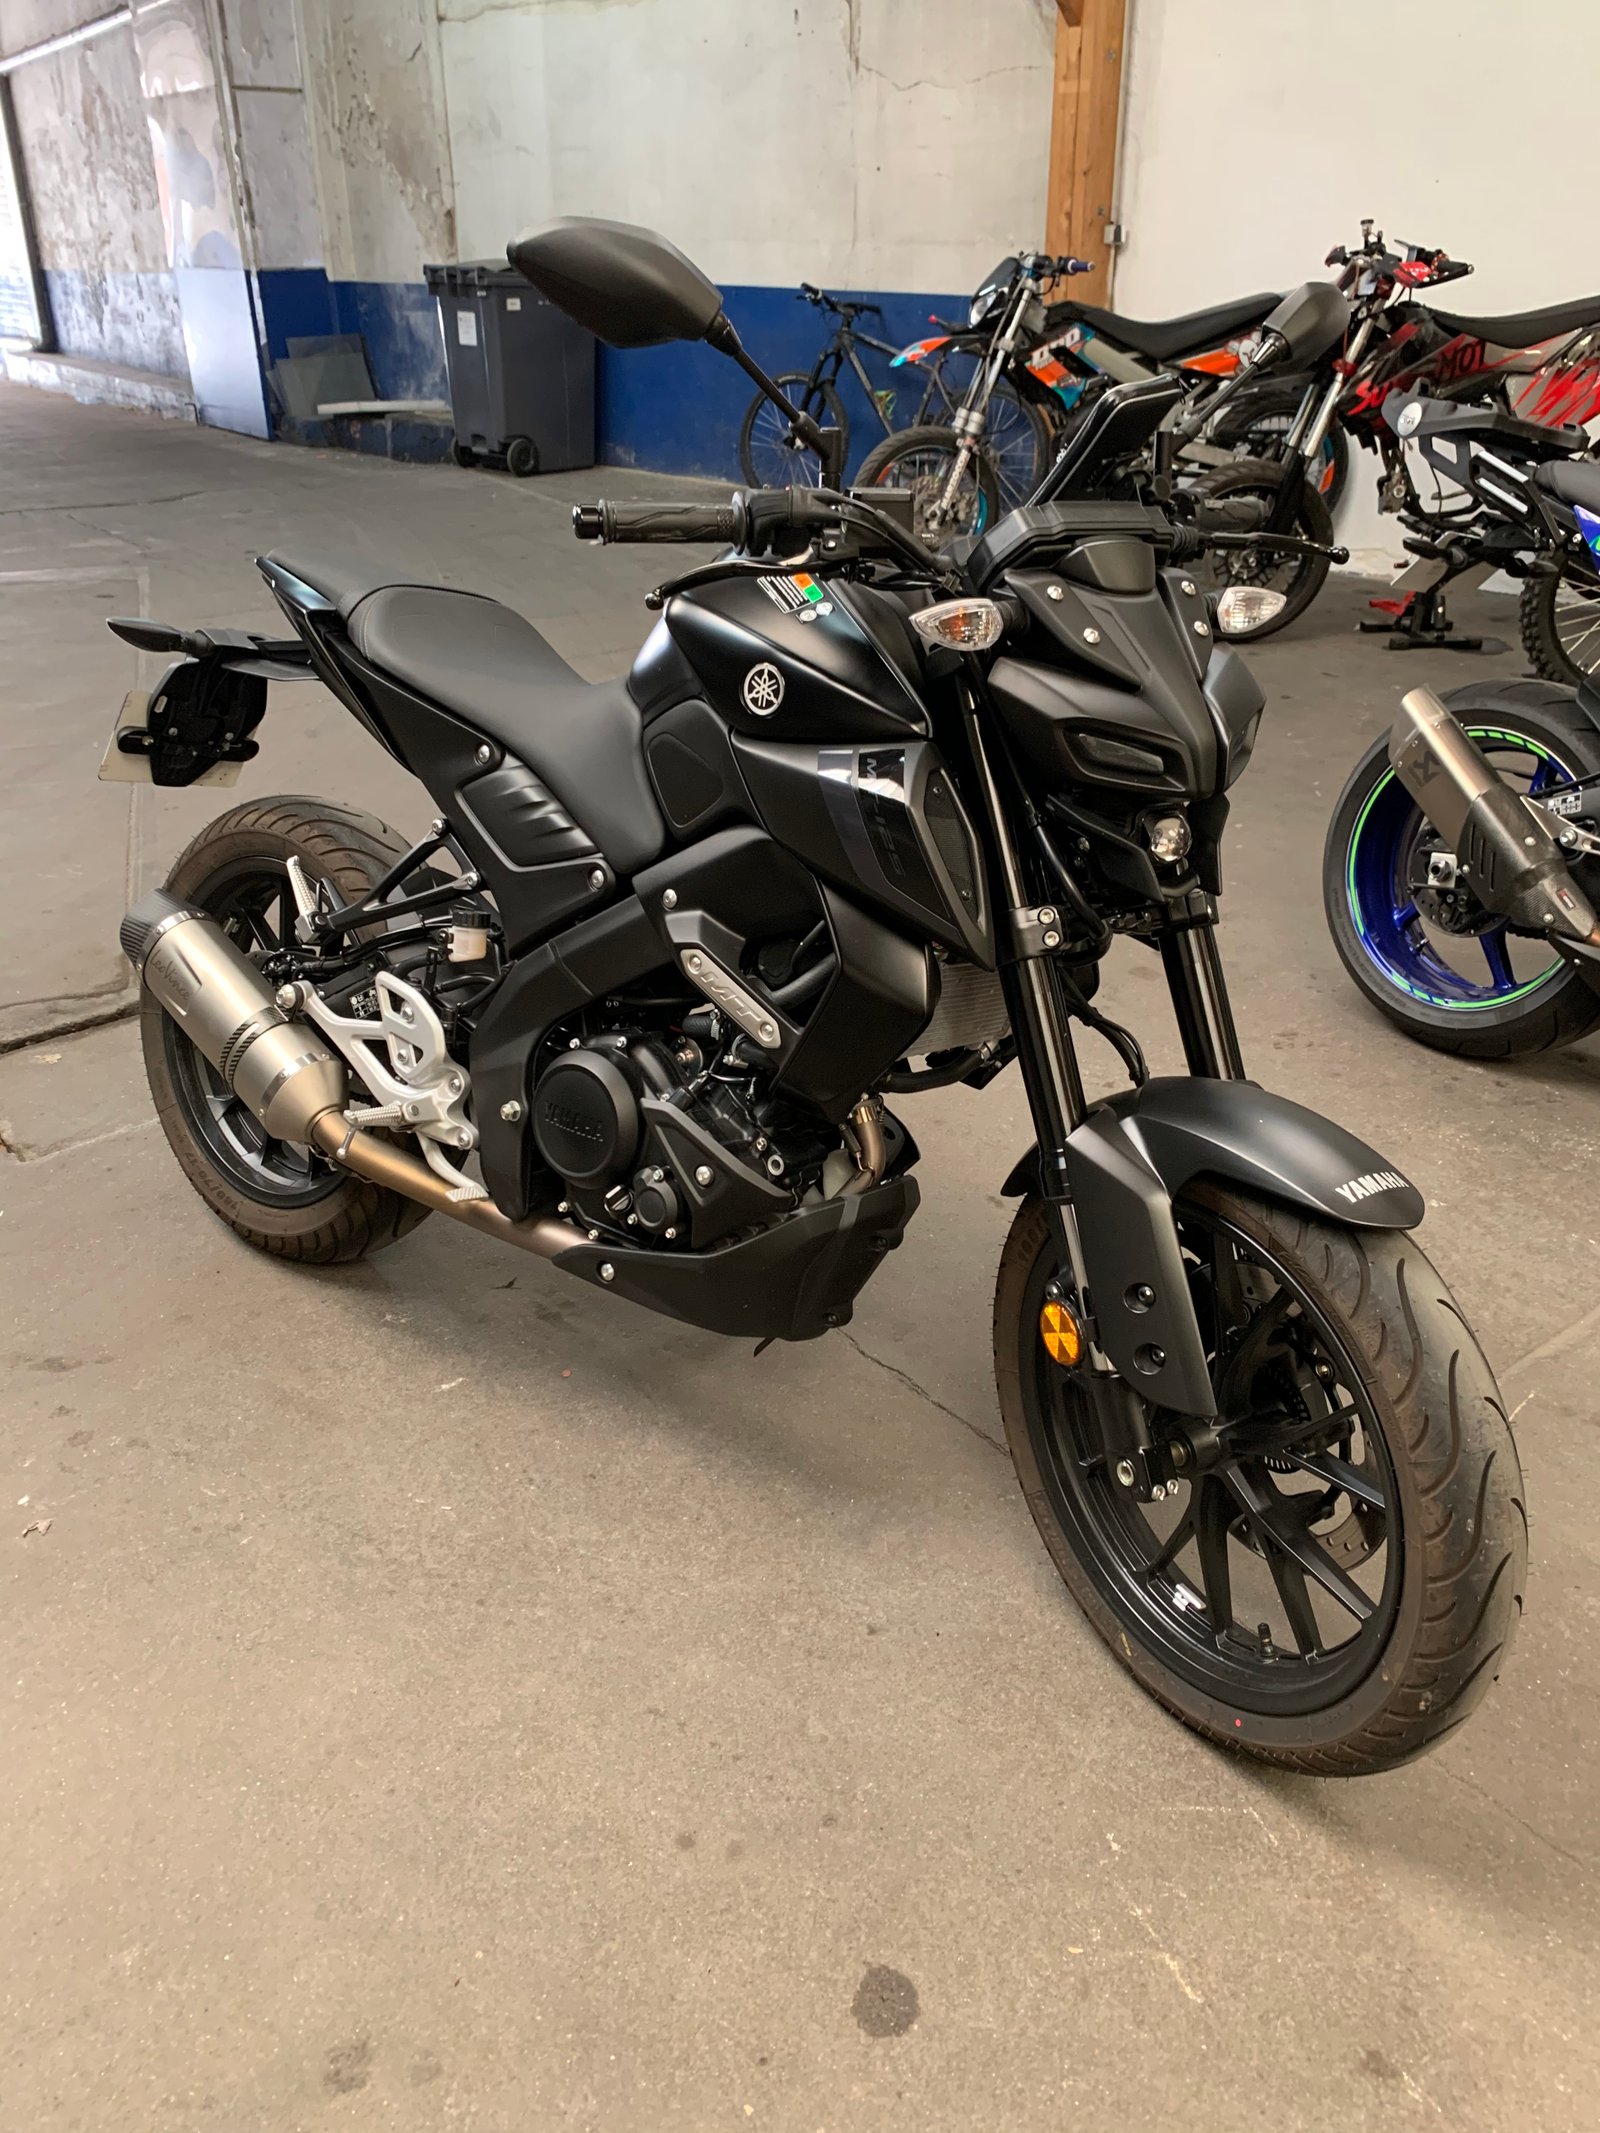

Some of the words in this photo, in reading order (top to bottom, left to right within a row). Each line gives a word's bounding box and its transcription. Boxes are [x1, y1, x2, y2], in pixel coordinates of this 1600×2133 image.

[151, 949, 190, 1000] LeoVince
[701, 971, 761, 1021] MT
[1334, 1171, 1410, 1203] YAMAHA
